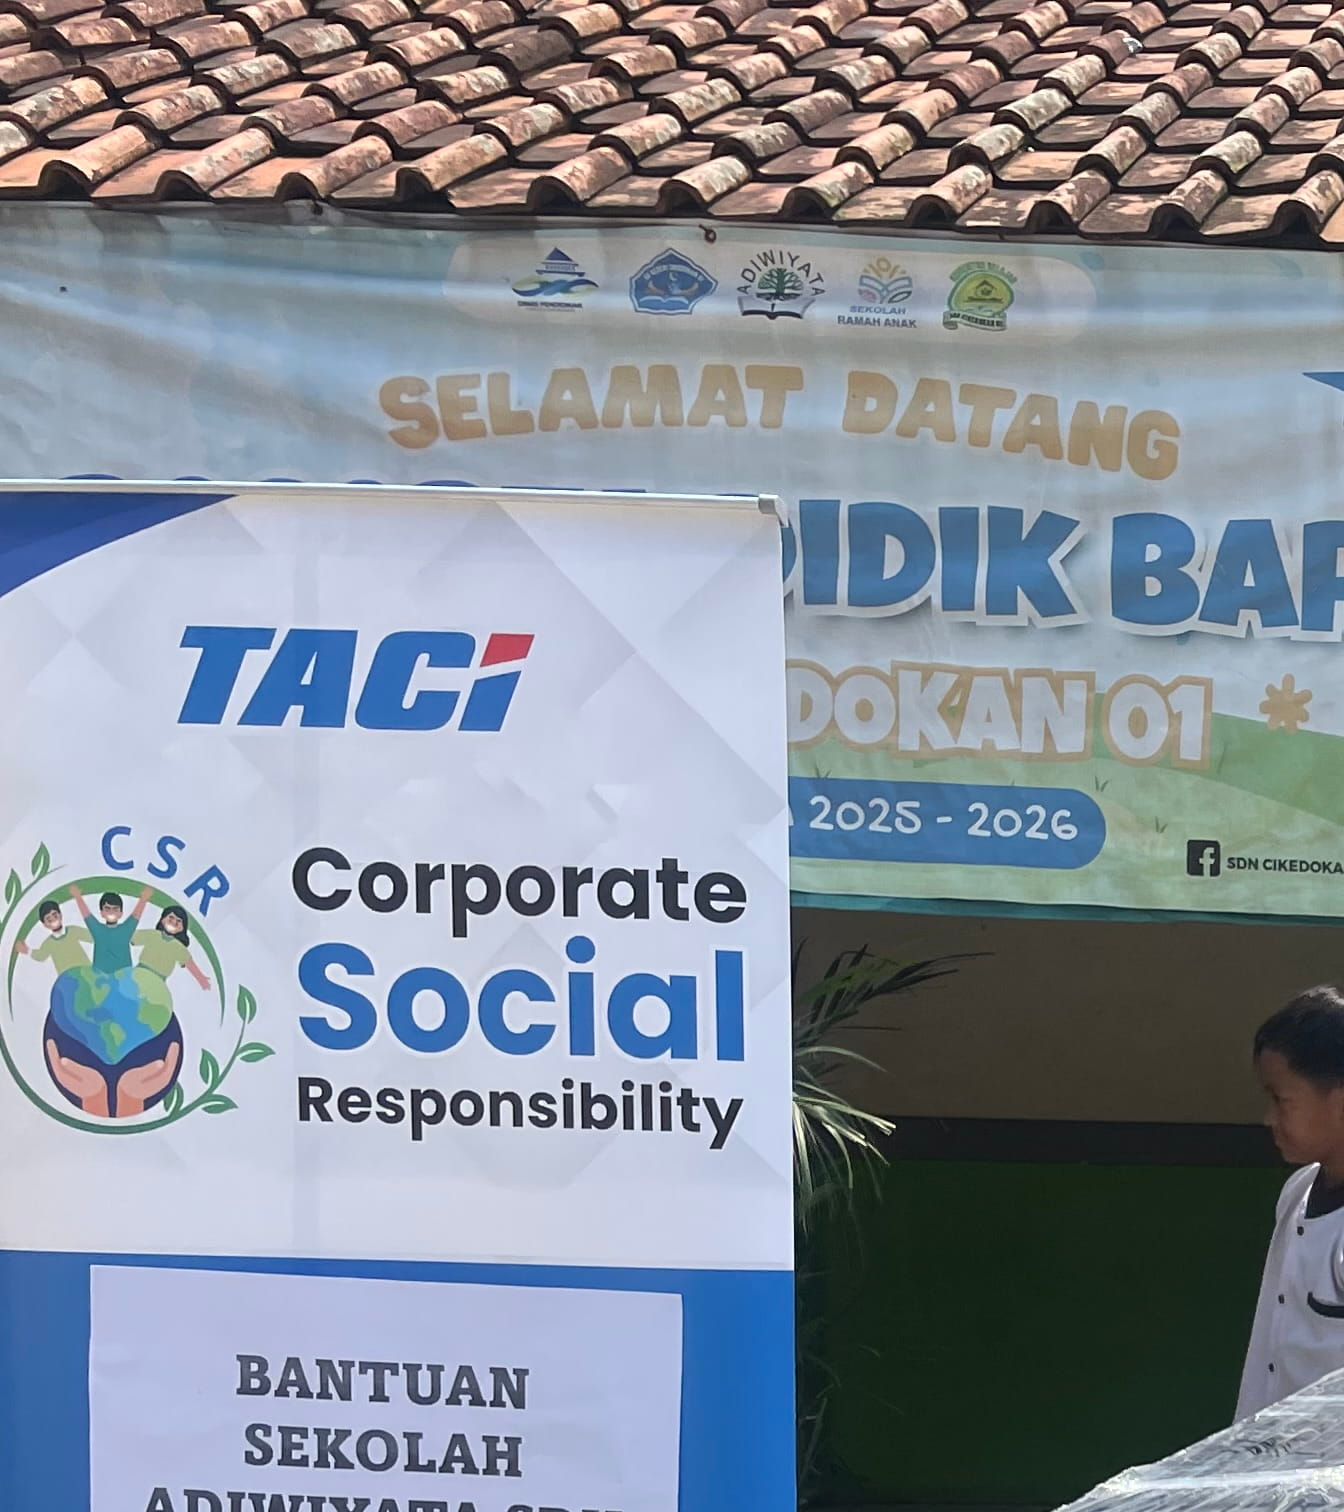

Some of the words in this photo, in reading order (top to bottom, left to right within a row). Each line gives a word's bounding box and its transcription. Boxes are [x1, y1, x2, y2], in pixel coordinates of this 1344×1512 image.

[737, 249, 826, 296] ADIWIYATA
[837, 315, 881, 328] RAMAH
[883, 317, 918, 329] ANAK
[850, 305, 906, 315] SEKOLAH
[378, 364, 804, 449] SELAMAT
[842, 369, 1182, 480] DATANG
[783, 499, 1083, 618] IDIK
[1105, 674, 1213, 770] 01
[808, 795, 923, 835] 2025
[967, 802, 1079, 842] 2026
[101, 825, 231, 916] CSR
[291, 846, 748, 938] Corporate
[1227, 857, 1259, 871] SDN
[298, 935, 745, 1062] Social
[298, 1076, 745, 1150] Responsibility
[236, 1353, 529, 1409] BANTUAN
[244, 1423, 523, 1477] SEKOLAH
